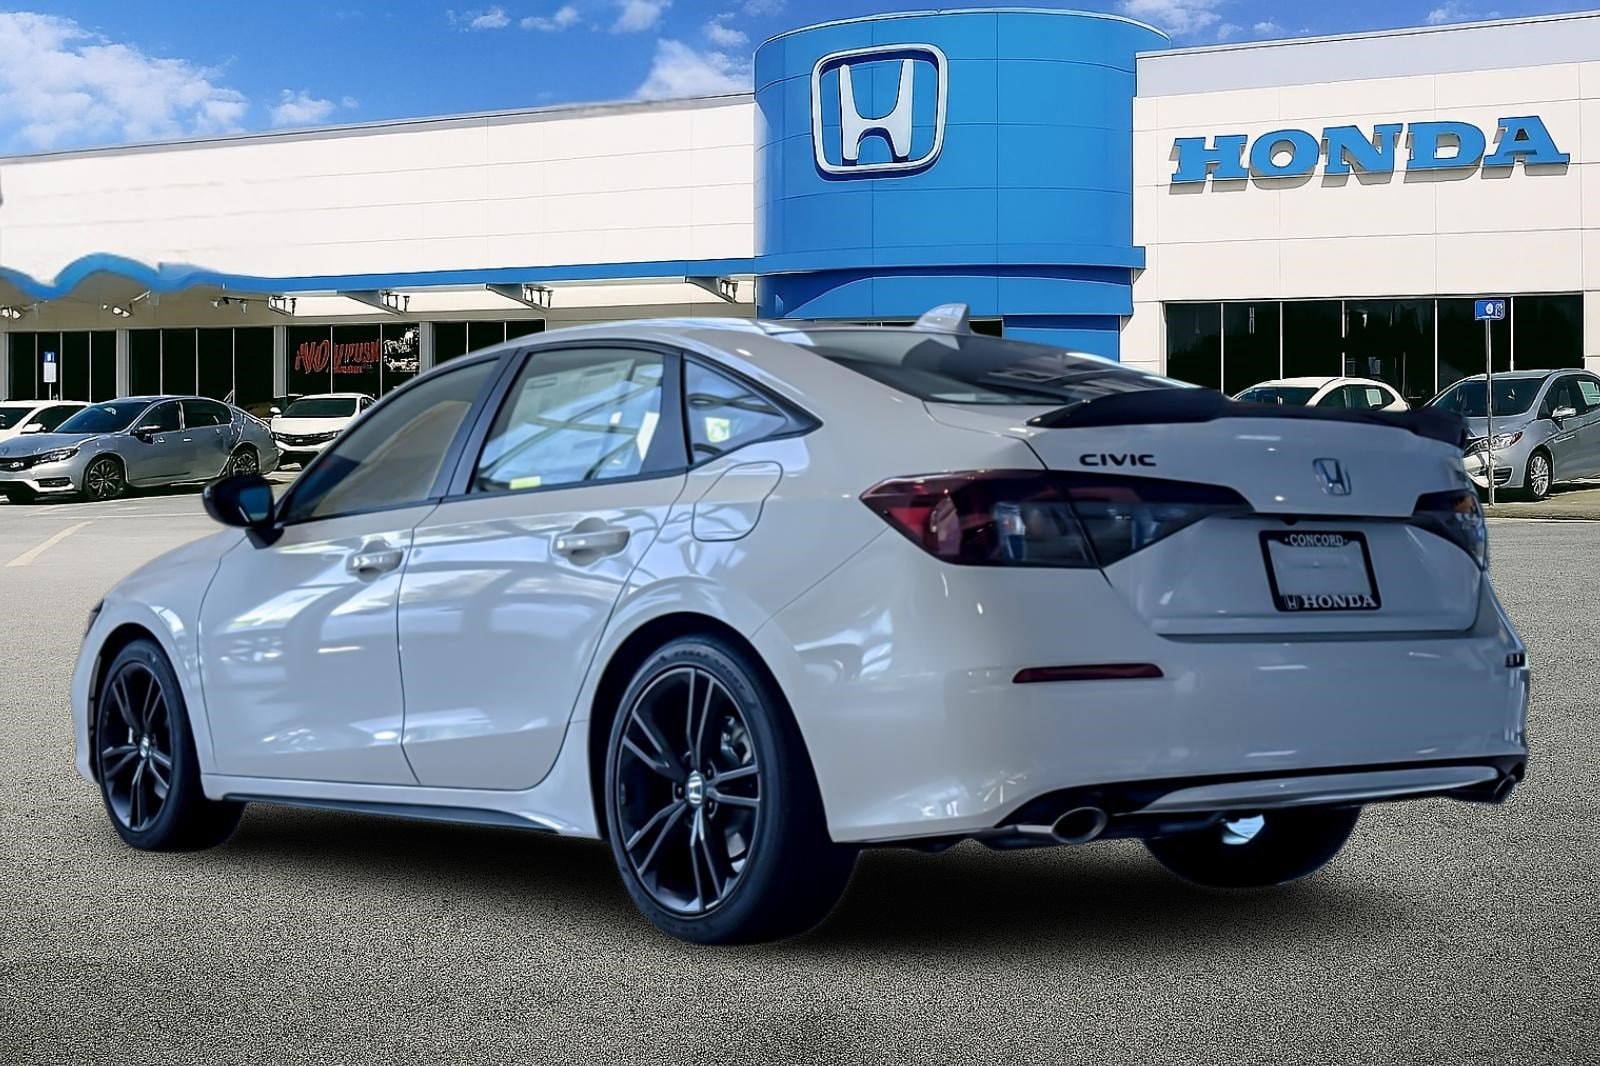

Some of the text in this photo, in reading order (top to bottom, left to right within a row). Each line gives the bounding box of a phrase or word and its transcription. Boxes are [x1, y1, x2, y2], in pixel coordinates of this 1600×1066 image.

[1170, 115, 1571, 187] HONDA
[1079, 453, 1157, 467] CIVIC
[1289, 534, 1344, 546] CONCORD
[1303, 594, 1378, 608] HONDA
